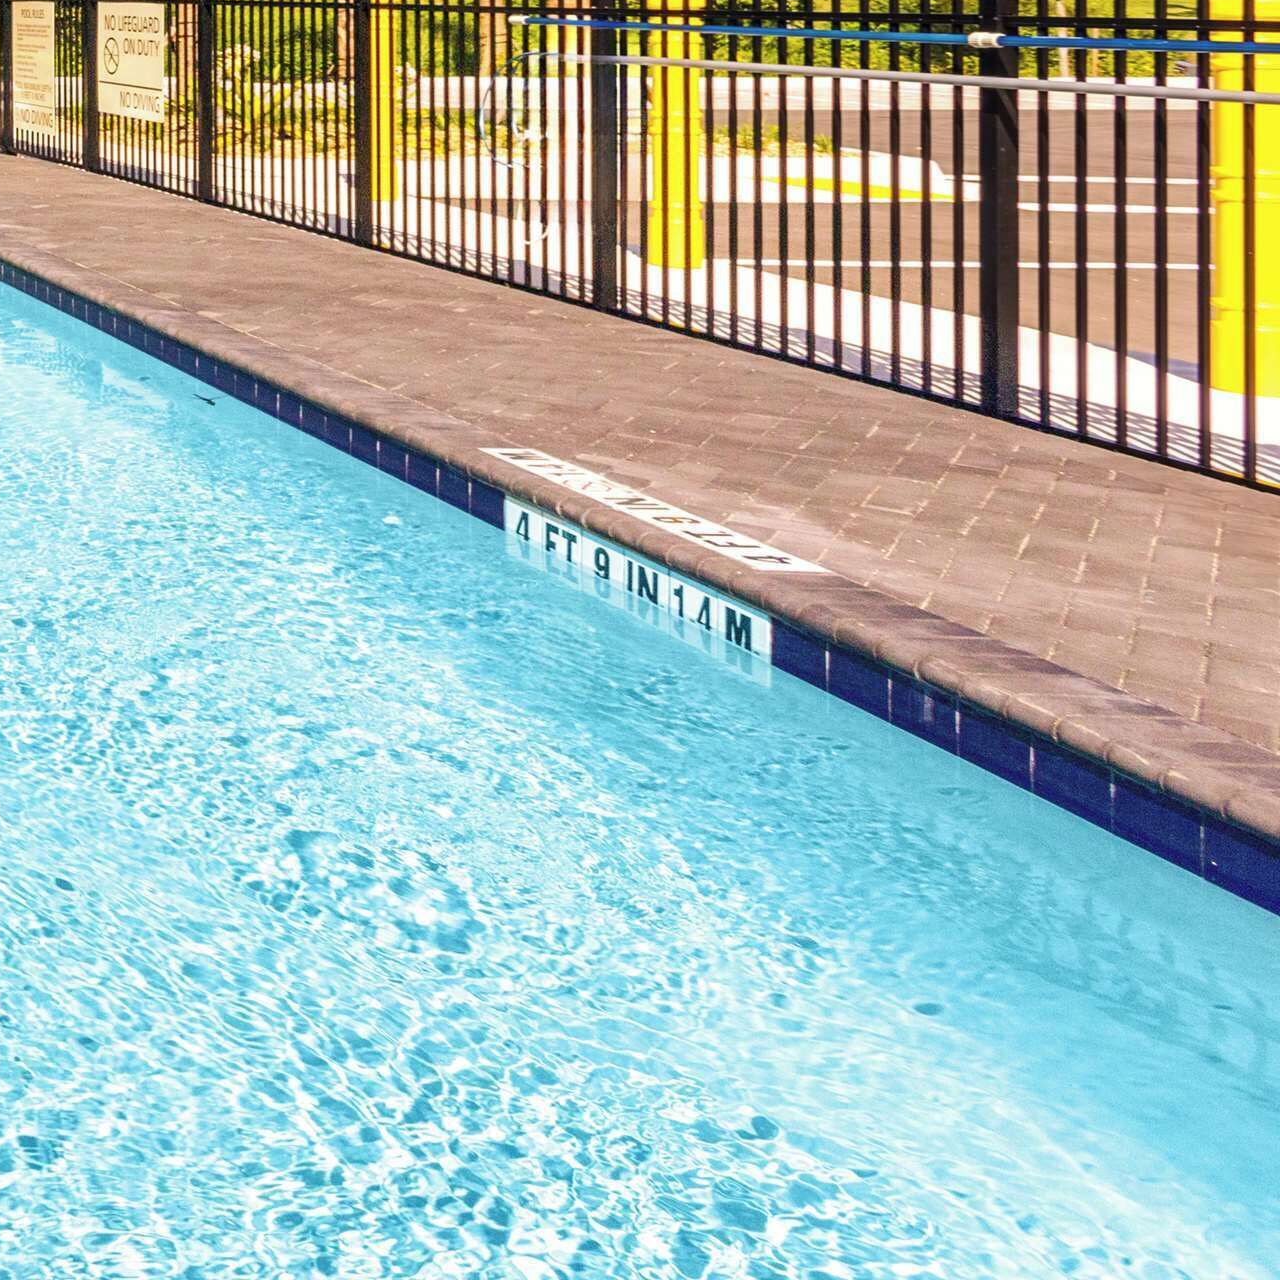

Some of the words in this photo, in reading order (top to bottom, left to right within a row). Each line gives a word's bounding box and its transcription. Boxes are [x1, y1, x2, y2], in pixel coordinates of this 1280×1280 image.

[104, 14, 116, 31] NO
[118, 15, 160, 34] LIFEGUARD
[123, 37, 136, 55] ON
[137, 39, 160, 57] DUTY
[120, 91, 131, 108] NO
[132, 93, 160, 114] DIVING
[20, 108, 30, 123] NO
[32, 110, 53, 128] DIVING
[516, 511, 530, 542] 4
[593, 546, 610, 580] 9
[673, 584, 712, 631] 1.4
